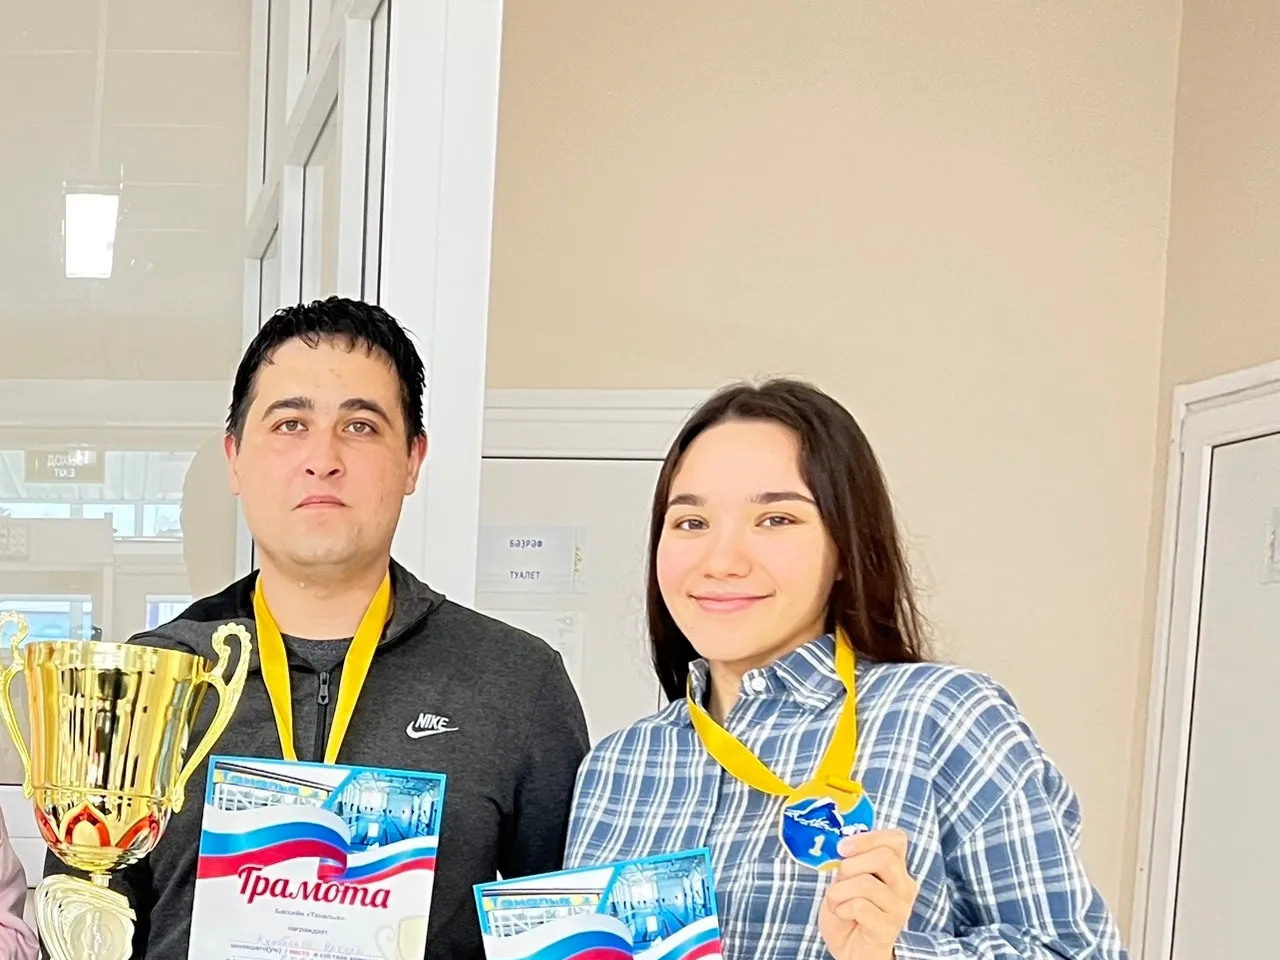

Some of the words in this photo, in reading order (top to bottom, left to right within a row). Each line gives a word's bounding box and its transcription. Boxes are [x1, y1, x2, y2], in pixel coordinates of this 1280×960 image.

[510, 571, 540, 580] ТУАЛЕТ
[415, 712, 450, 730] NIKE
[808, 834, 826, 857] 1
[238, 866, 392, 909] Грамота
